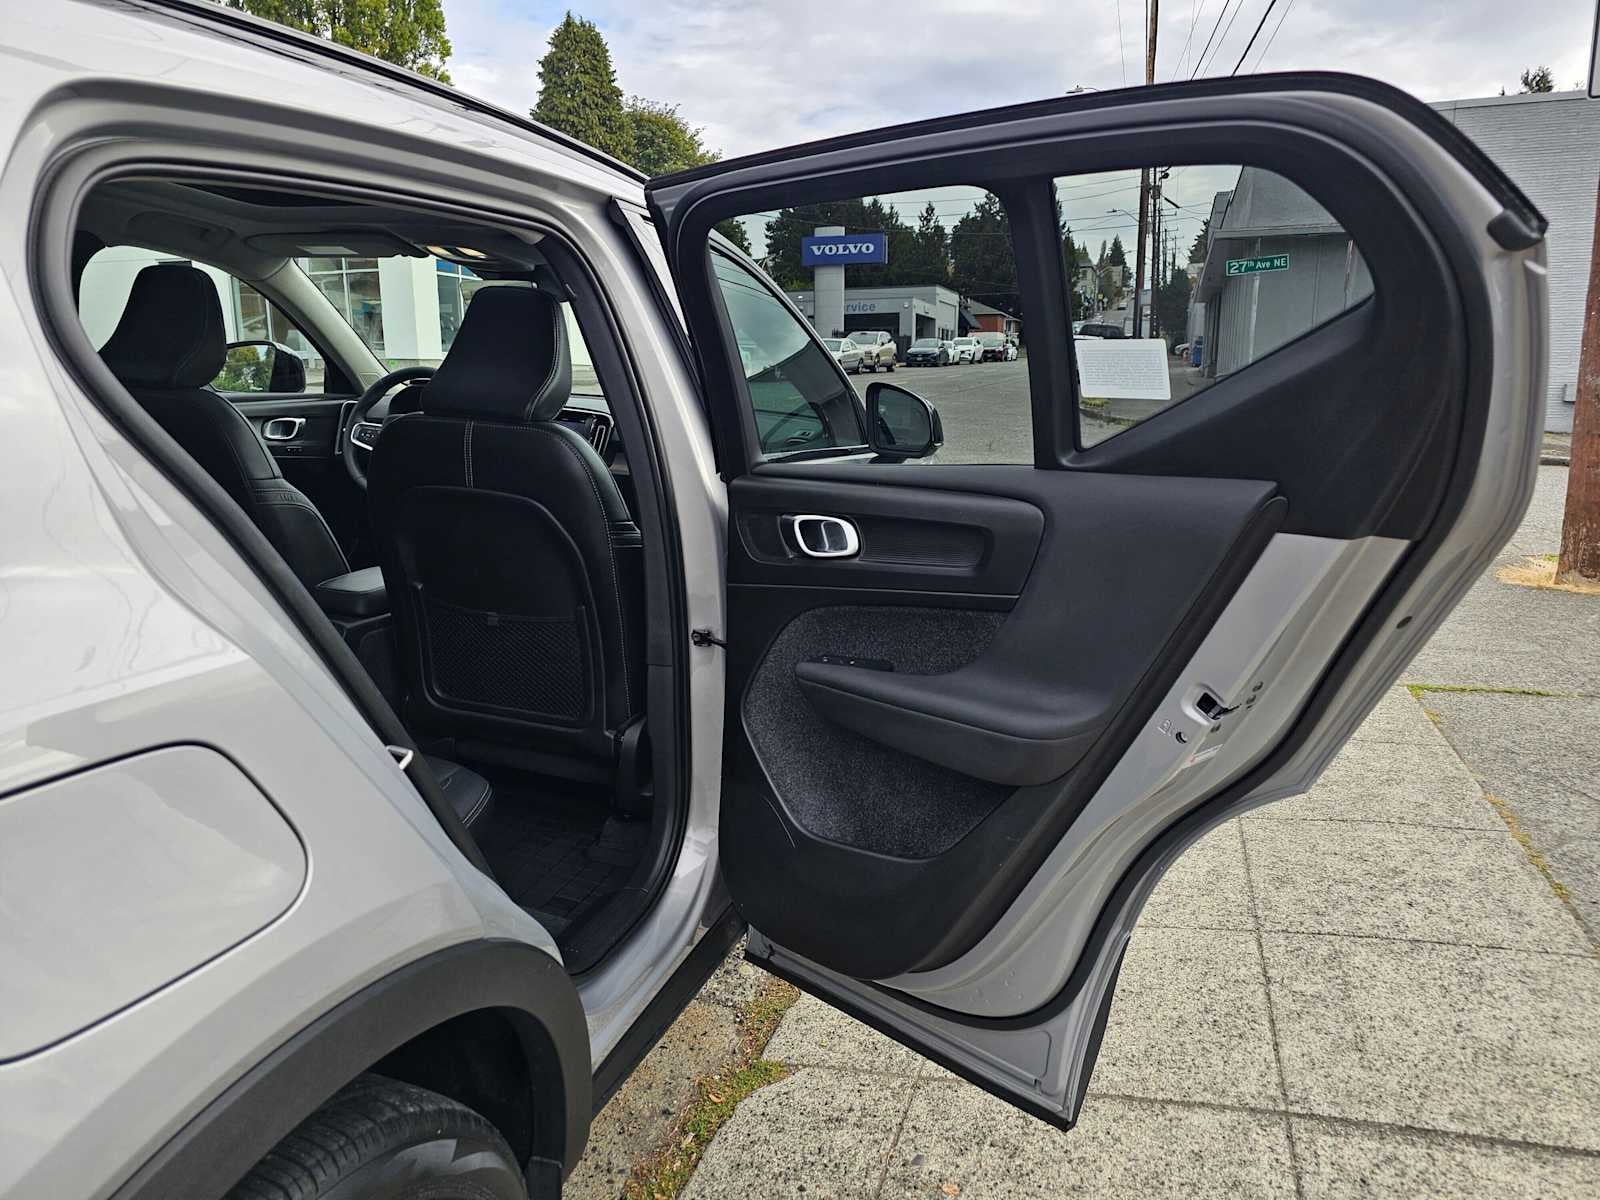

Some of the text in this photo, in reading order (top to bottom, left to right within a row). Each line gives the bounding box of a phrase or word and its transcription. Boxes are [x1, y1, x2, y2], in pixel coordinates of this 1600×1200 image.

[810, 243, 875, 256] VOLVO
[1256, 261, 1271, 269] Ave
[1274, 258, 1287, 266] NE
[846, 302, 876, 312] rvice
